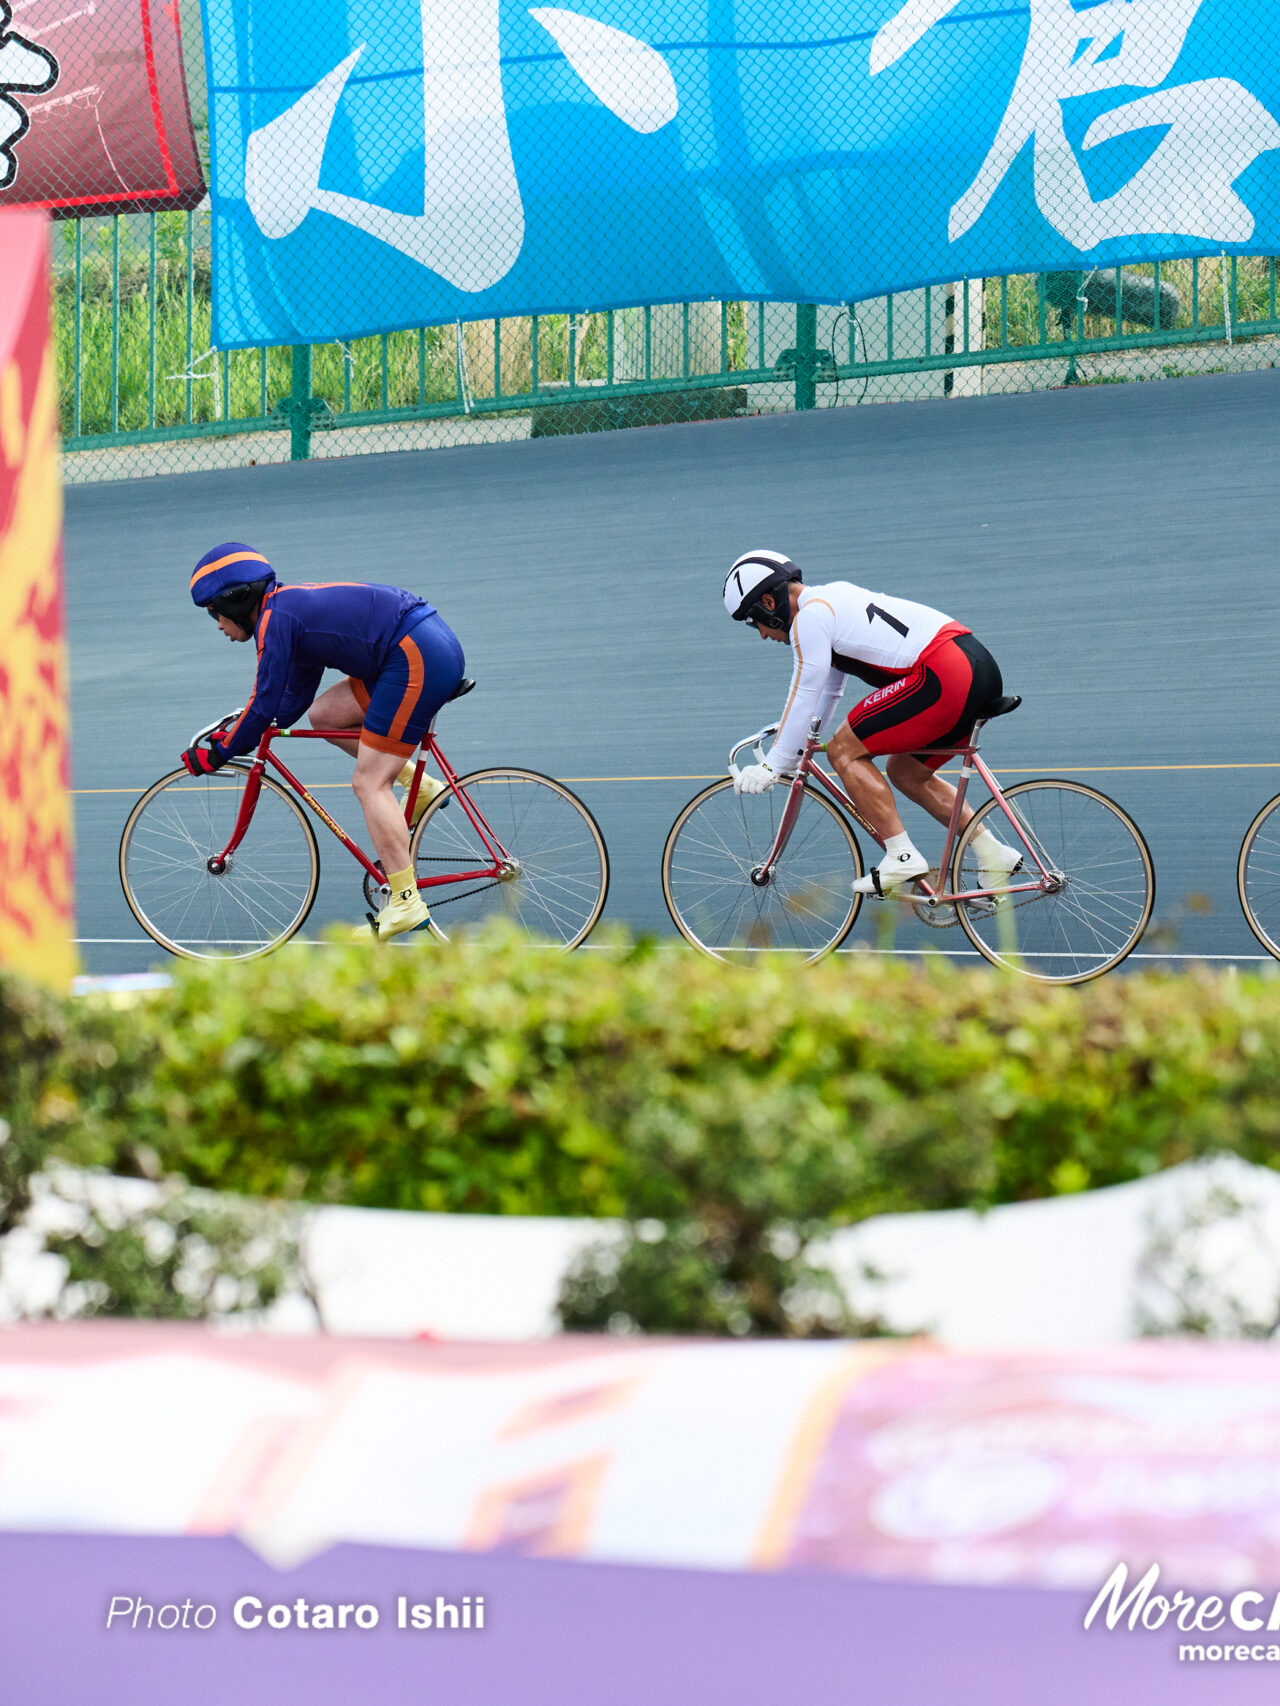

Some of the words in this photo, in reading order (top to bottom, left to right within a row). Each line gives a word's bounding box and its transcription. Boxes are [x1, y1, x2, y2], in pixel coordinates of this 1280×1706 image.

[733, 570, 744, 596] 1
[866, 603, 910, 638] 1
[863, 678, 907, 708] KEIRIN
[303, 792, 346, 841] Panasonic
